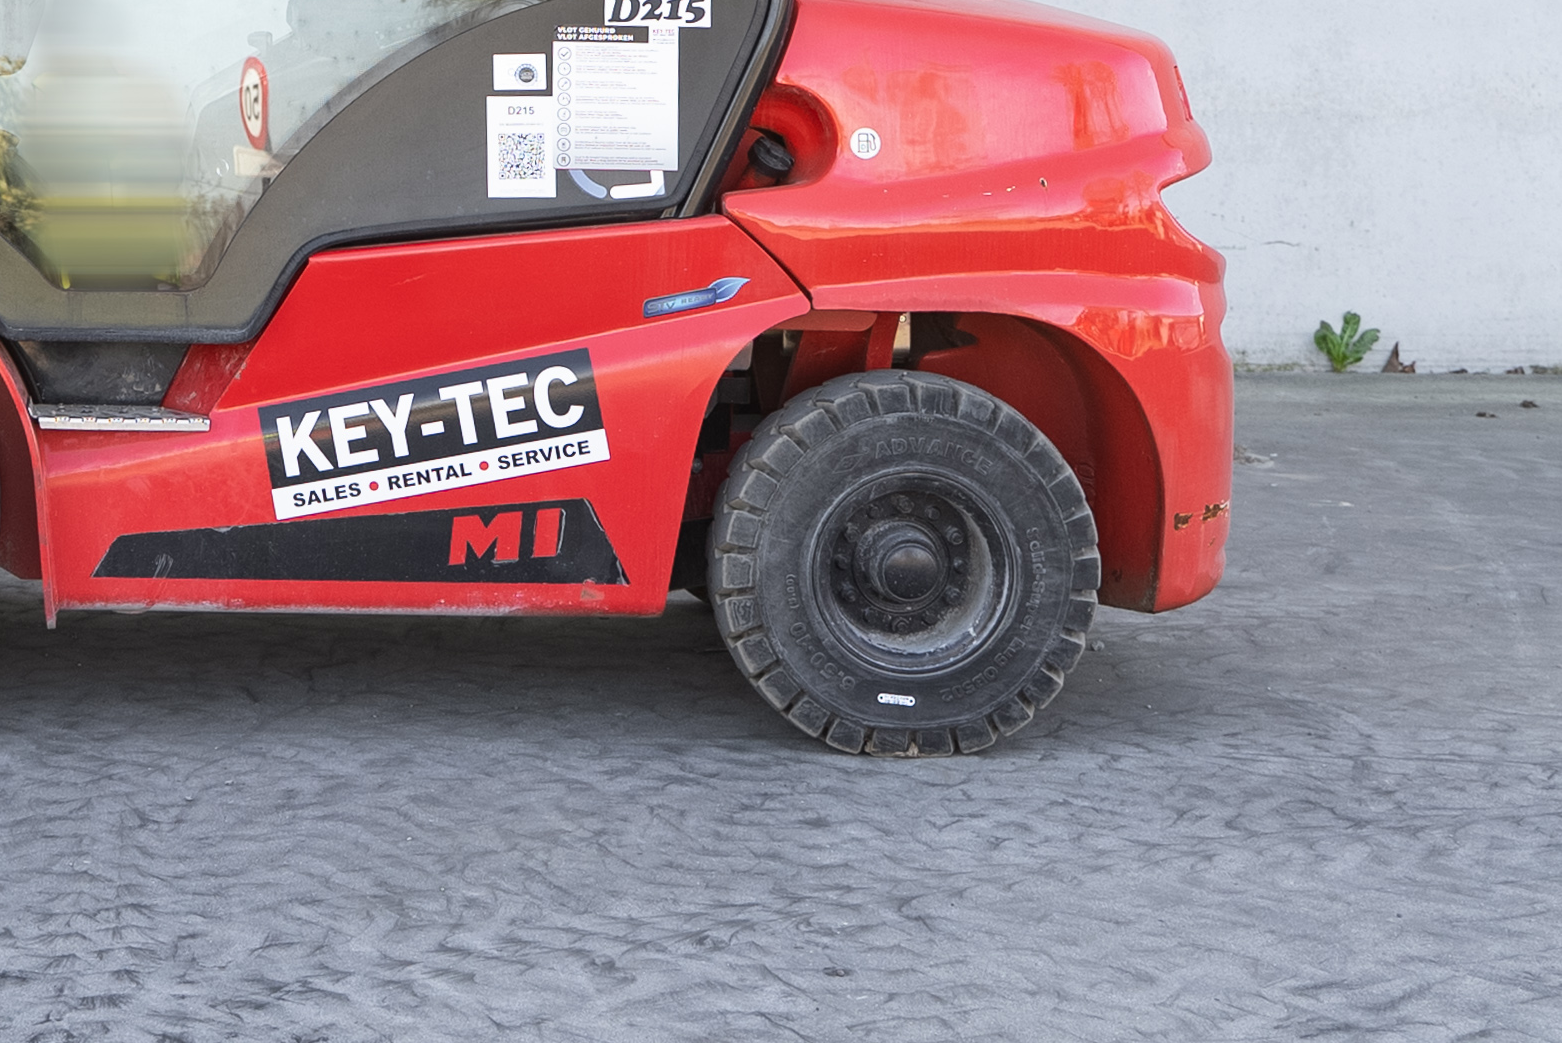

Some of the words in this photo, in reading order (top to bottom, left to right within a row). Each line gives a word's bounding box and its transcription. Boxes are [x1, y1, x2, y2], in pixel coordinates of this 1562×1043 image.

[556, 33, 577, 41] VLOT
[557, 26, 578, 34] VLOT
[507, 106, 535, 115] D215
[680, 292, 715, 305] READY
[276, 365, 585, 478] KEY-TEC
[875, 436, 994, 476] ADVANCE
[292, 482, 362, 508] SALES
[387, 462, 473, 491] RENTAL
[497, 440, 591, 471] SERVICE
[448, 507, 564, 566] MI
[994, 636, 1026, 667] Lug
